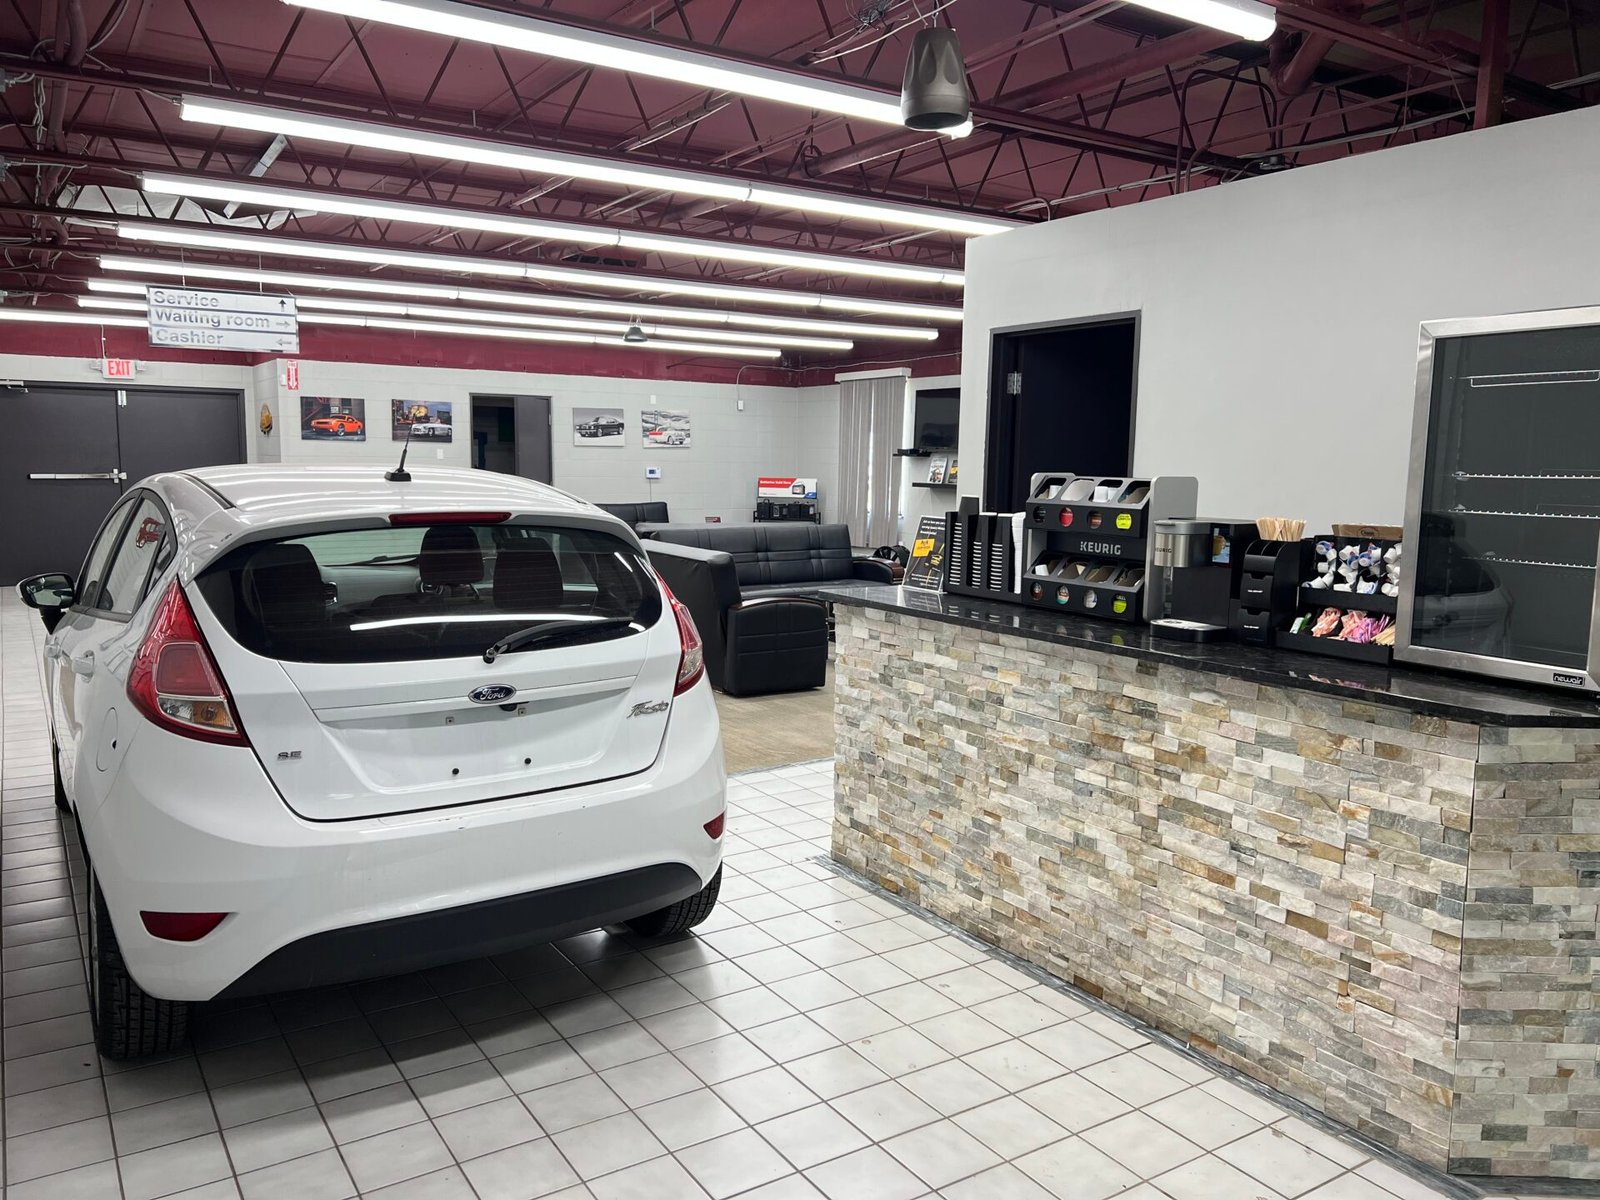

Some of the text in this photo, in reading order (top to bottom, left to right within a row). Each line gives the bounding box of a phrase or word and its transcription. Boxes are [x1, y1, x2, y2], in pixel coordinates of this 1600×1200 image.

[153, 290, 220, 308] Service
[155, 309, 270, 328] Waiting room
[156, 328, 224, 344] Cashier
[107, 360, 131, 376] EXIT
[1080, 541, 1121, 555] KEURIG
[1553, 675, 1583, 684] newair
[480, 687, 506, 701] Ford
[278, 751, 302, 760] SE
